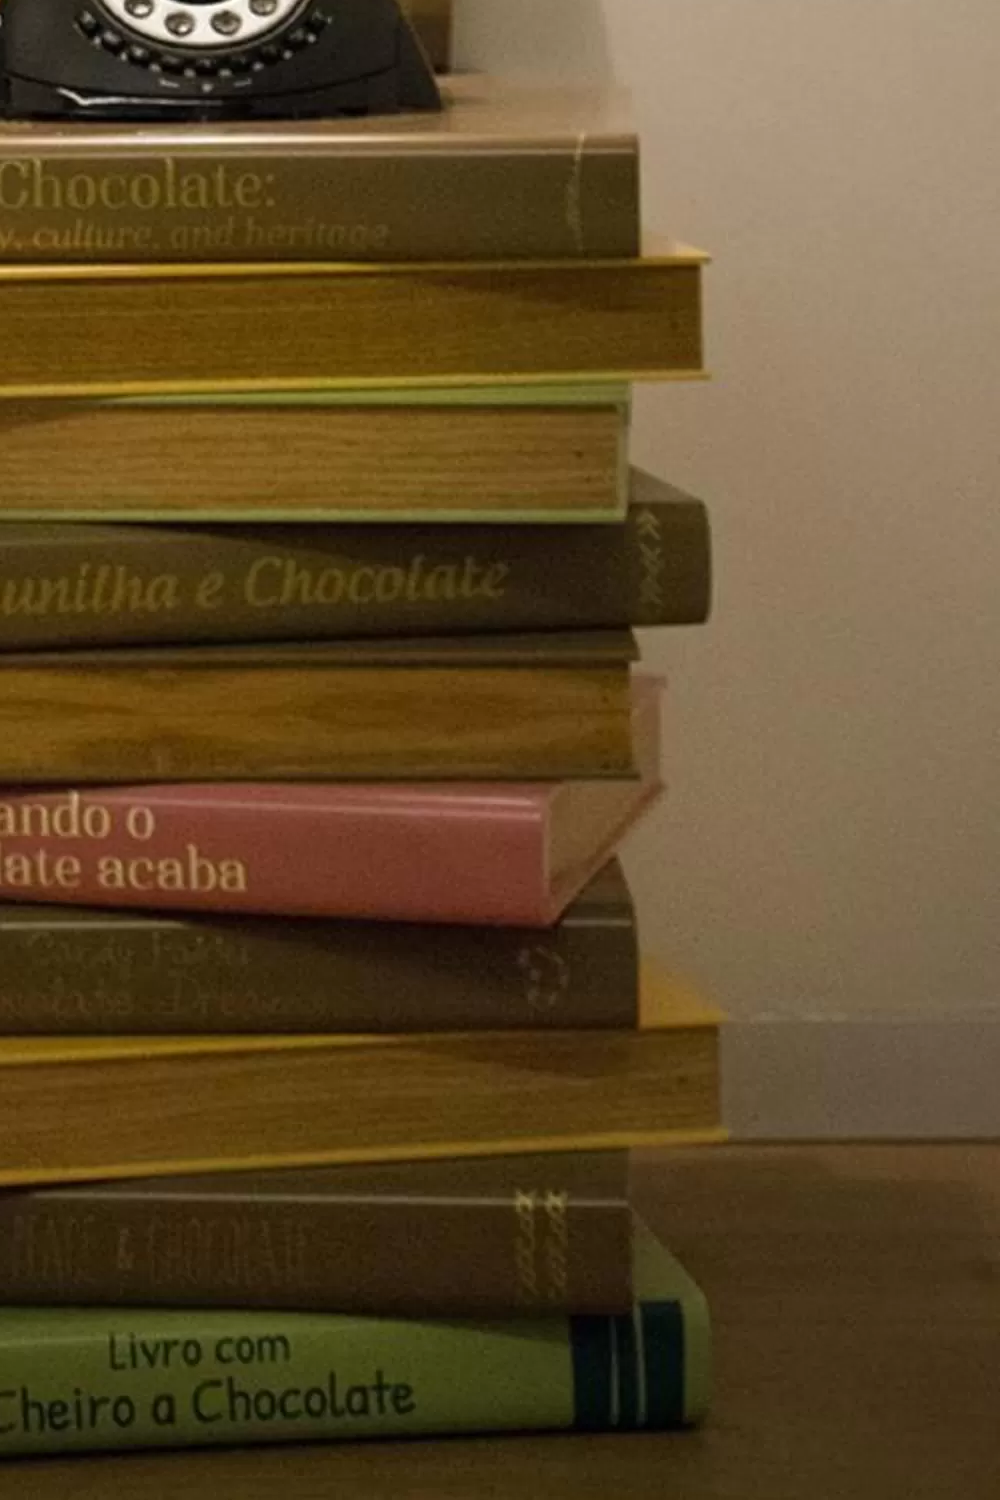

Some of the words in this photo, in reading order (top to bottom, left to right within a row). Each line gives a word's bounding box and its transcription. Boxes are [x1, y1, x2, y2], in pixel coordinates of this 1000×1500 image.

[171, 216, 234, 250] and
[195, 572, 223, 608] e
[244, 554, 511, 608] Chocolate
[125, 804, 155, 841] o
[99, 843, 247, 893] acaba
[109, 1331, 201, 1371] Livro
[215, 1333, 290, 1364] com
[151, 1393, 176, 1426] a
[192, 1368, 418, 1424] Chocolate
